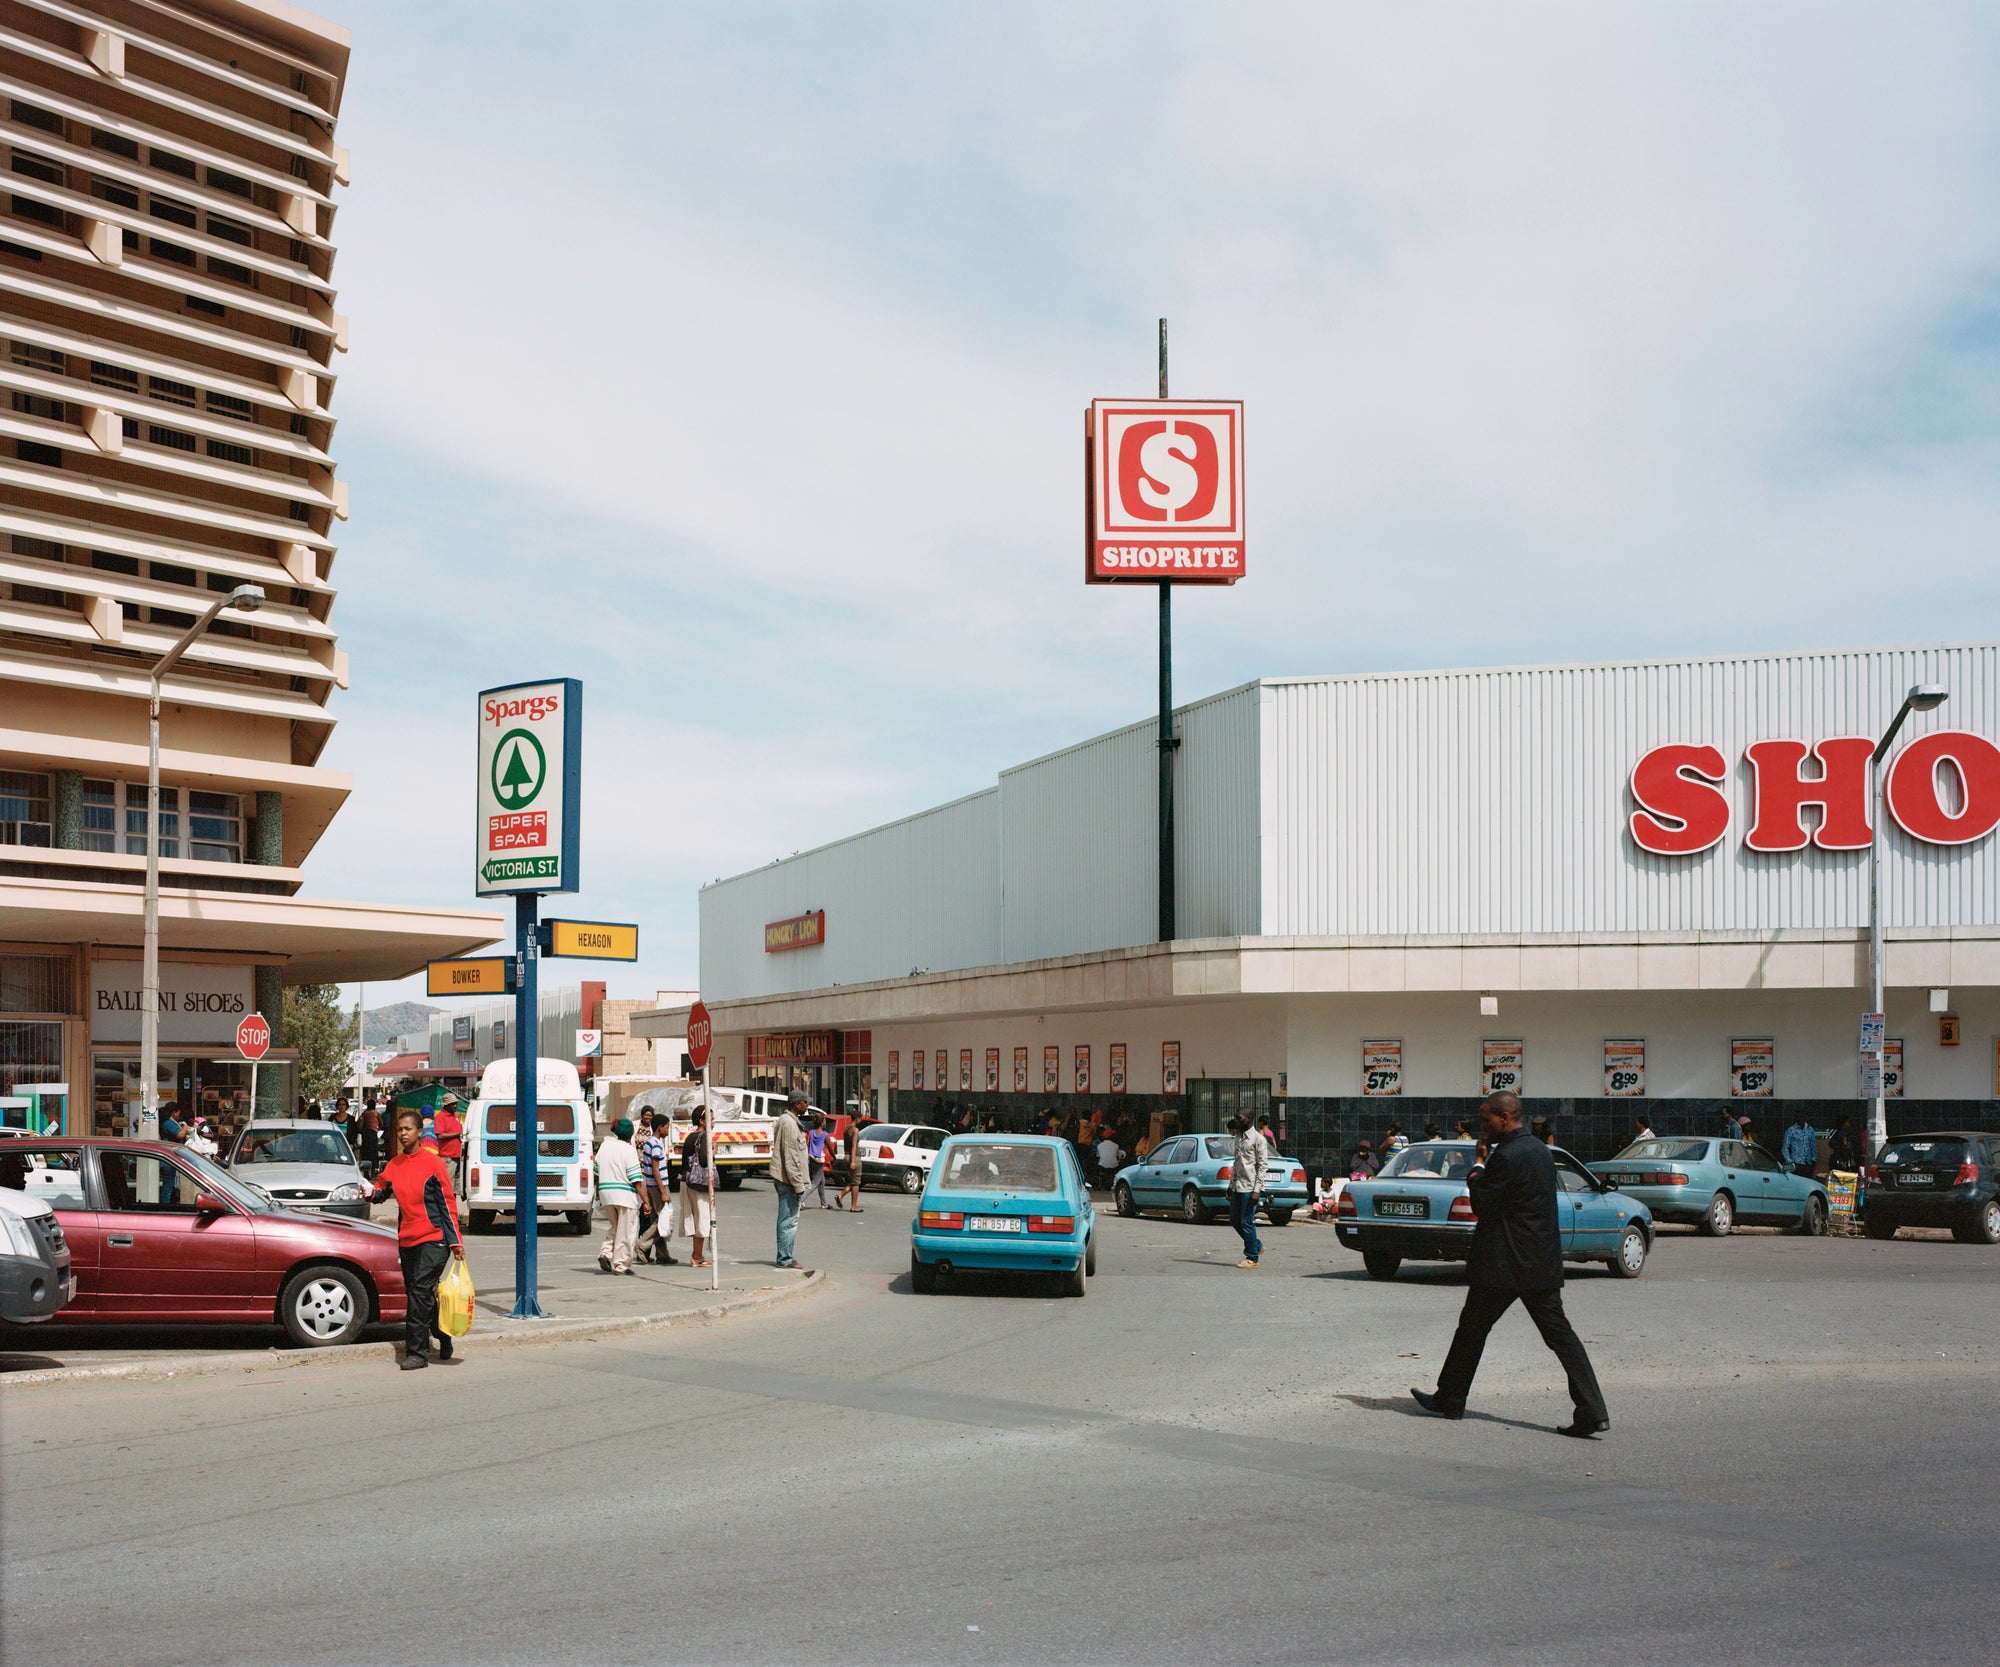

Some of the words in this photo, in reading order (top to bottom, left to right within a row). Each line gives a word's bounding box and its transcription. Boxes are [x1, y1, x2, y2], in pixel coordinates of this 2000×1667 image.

[1103, 546, 1239, 568] SHOPRITE
[485, 695, 558, 727] Spargs
[490, 813, 546, 831] SUPER
[494, 831, 540, 849] SPAR
[485, 861, 535, 879] VICTORIA
[538, 859, 556, 875] ST.
[578, 932, 612, 949] HEXAGON
[766, 923, 795, 947] HUNGRY
[799, 918, 818, 940] LION
[452, 968, 481, 984] BOWKER
[96, 990, 177, 1012] BALNI
[183, 991, 244, 1013] SHOES
[240, 1027, 268, 1046] STOP
[688, 1020, 709, 1049] STOP
[765, 1038, 799, 1058] HUNGRY
[805, 1036, 829, 1057] LION
[1367, 1072, 1398, 1089] 57.99
[1491, 1072, 1516, 1090] 12.99
[1611, 1072, 1638, 1090] 8.99
[1740, 1072, 1767, 1091] 13.99
[1413, 1205, 1423, 1214] EC
[990, 1218, 1007, 1229] 857
[1010, 1219, 1020, 1230] EC
